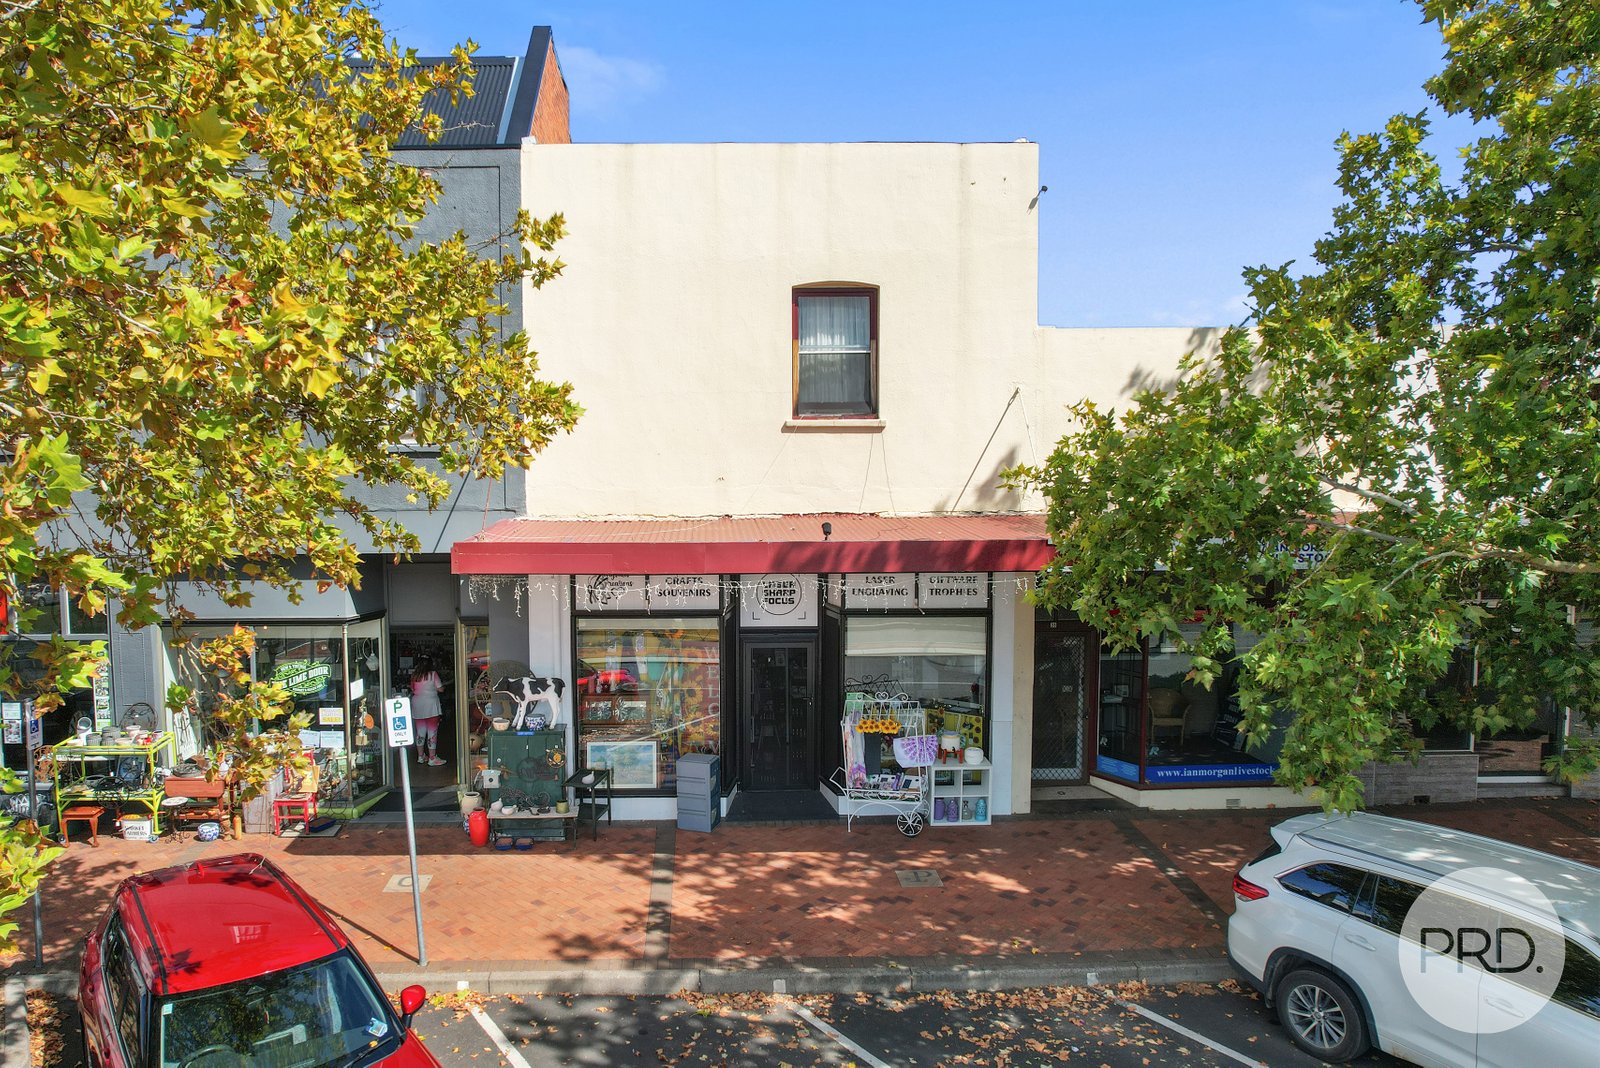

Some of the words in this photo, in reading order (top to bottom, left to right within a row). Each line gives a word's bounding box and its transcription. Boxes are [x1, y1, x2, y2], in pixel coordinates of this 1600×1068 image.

[665, 576, 703, 585] CRAFTS
[865, 575, 896, 584] LASER
[929, 575, 978, 584] GIFTWARE
[657, 588, 711, 597] SOUVENIRS
[763, 589, 796, 597] SHARP
[851, 588, 909, 596] ENGRAVING
[763, 597, 795, 605] FOCUS
[288, 671, 308, 687] LIME
[308, 665, 330, 679] DOOR
[393, 701, 403, 714] P
